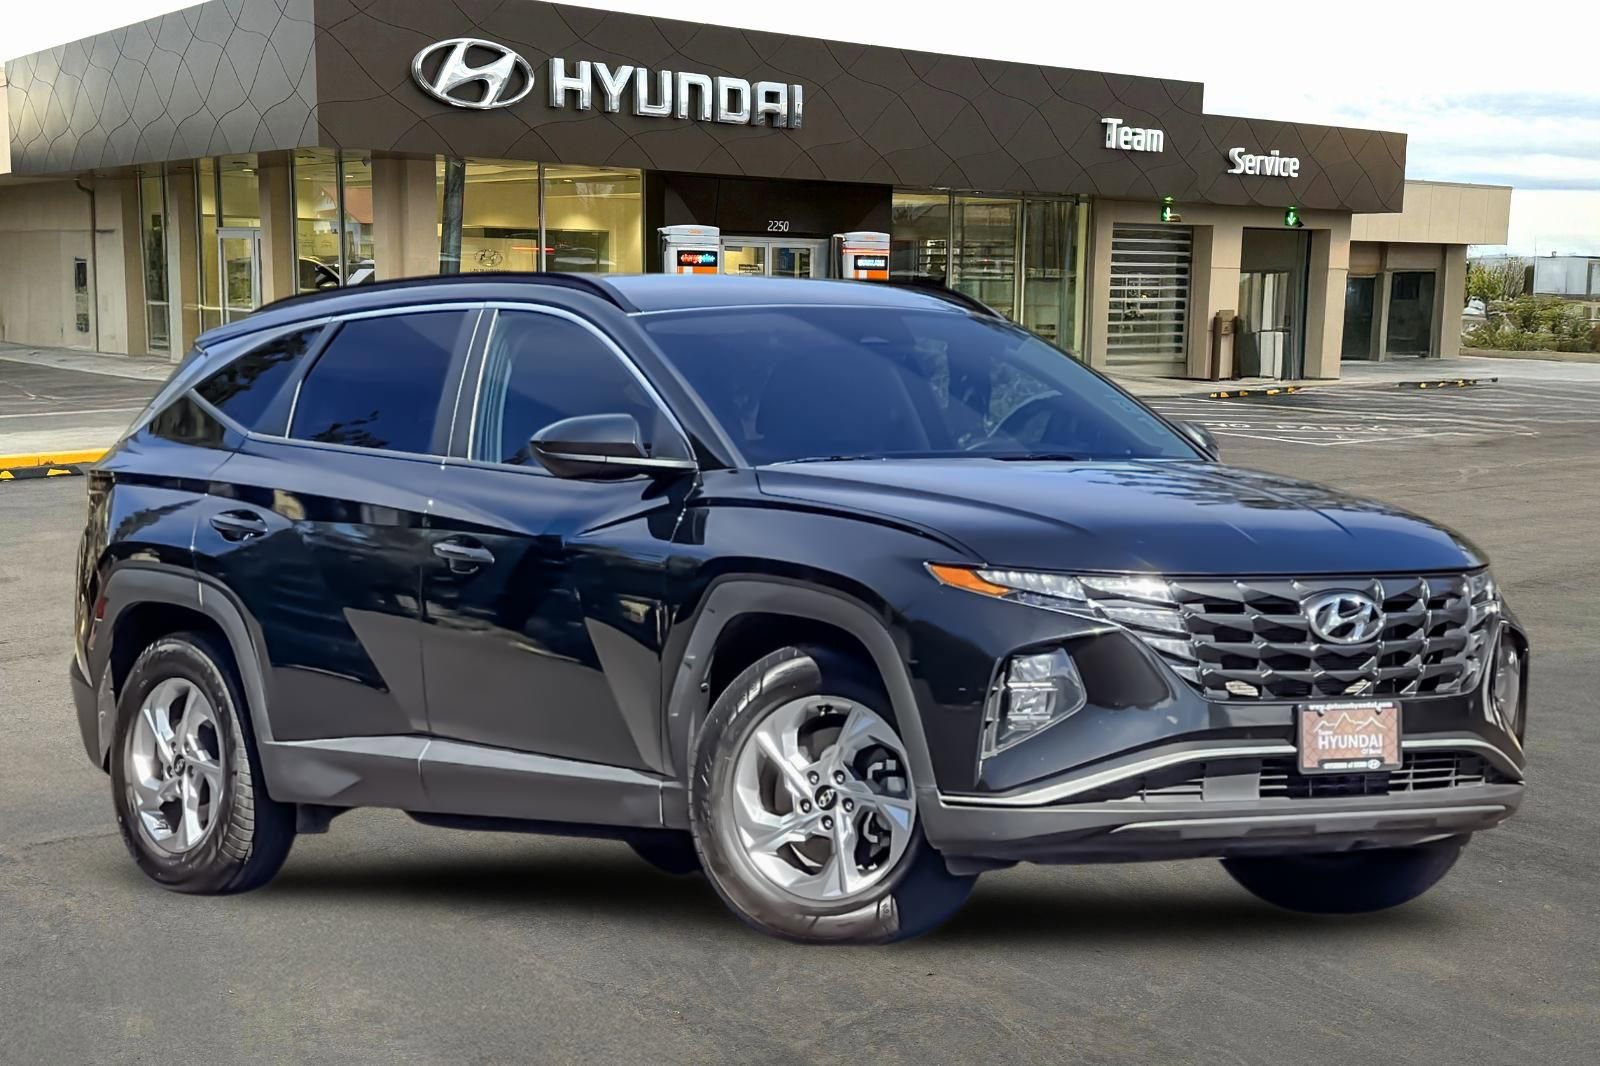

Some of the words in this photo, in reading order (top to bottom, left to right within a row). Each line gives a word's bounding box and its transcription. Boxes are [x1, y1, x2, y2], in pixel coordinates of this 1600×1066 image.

[548, 57, 803, 129] HYUNDAI
[1101, 117, 1164, 153] Team
[1227, 147, 1300, 178] Service
[767, 220, 790, 232] 2250
[1318, 734, 1383, 750] HYUNDAI
